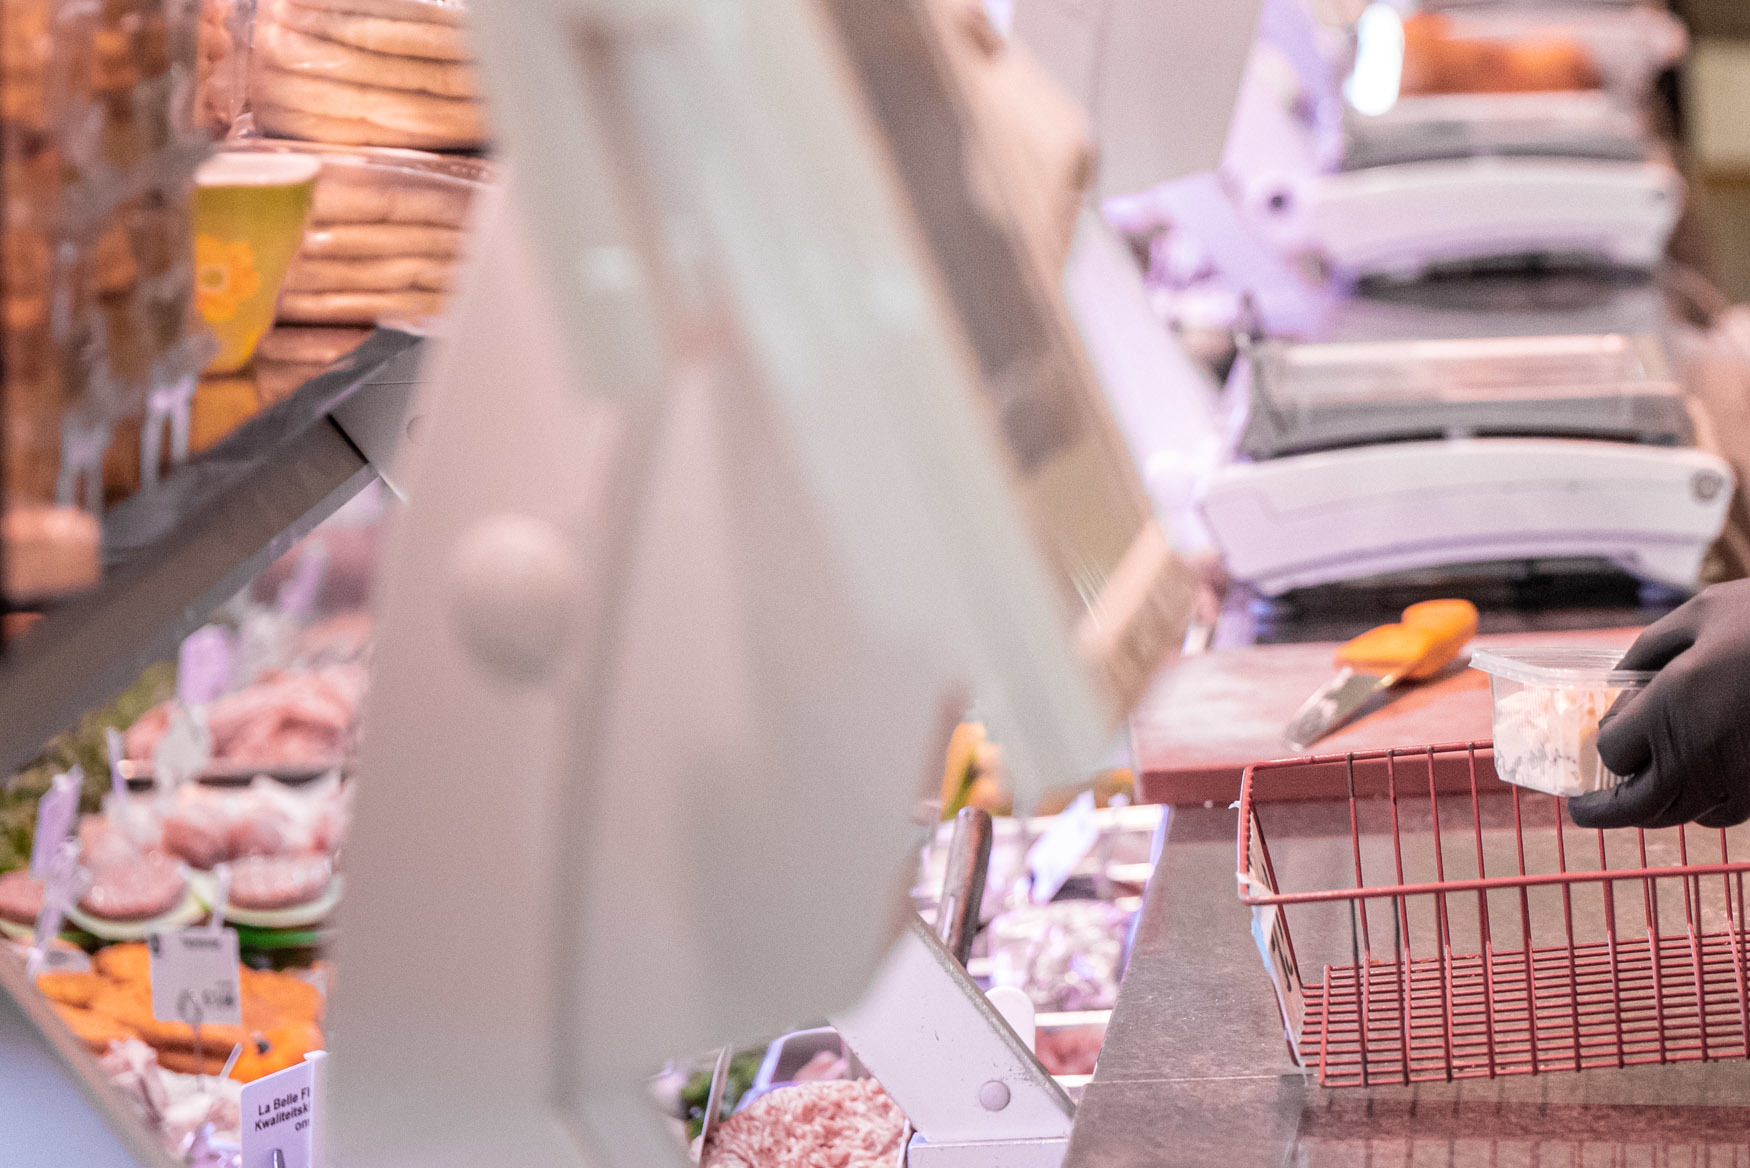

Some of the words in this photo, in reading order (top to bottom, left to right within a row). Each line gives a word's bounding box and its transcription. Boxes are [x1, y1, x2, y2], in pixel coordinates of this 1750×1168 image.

[258, 1104, 270, 1116] La
[273, 1093, 298, 1110] Belle
[301, 1086, 310, 1100] Fl
[255, 1101, 310, 1132] Kwaliteitsk
[295, 1118, 310, 1131] on
